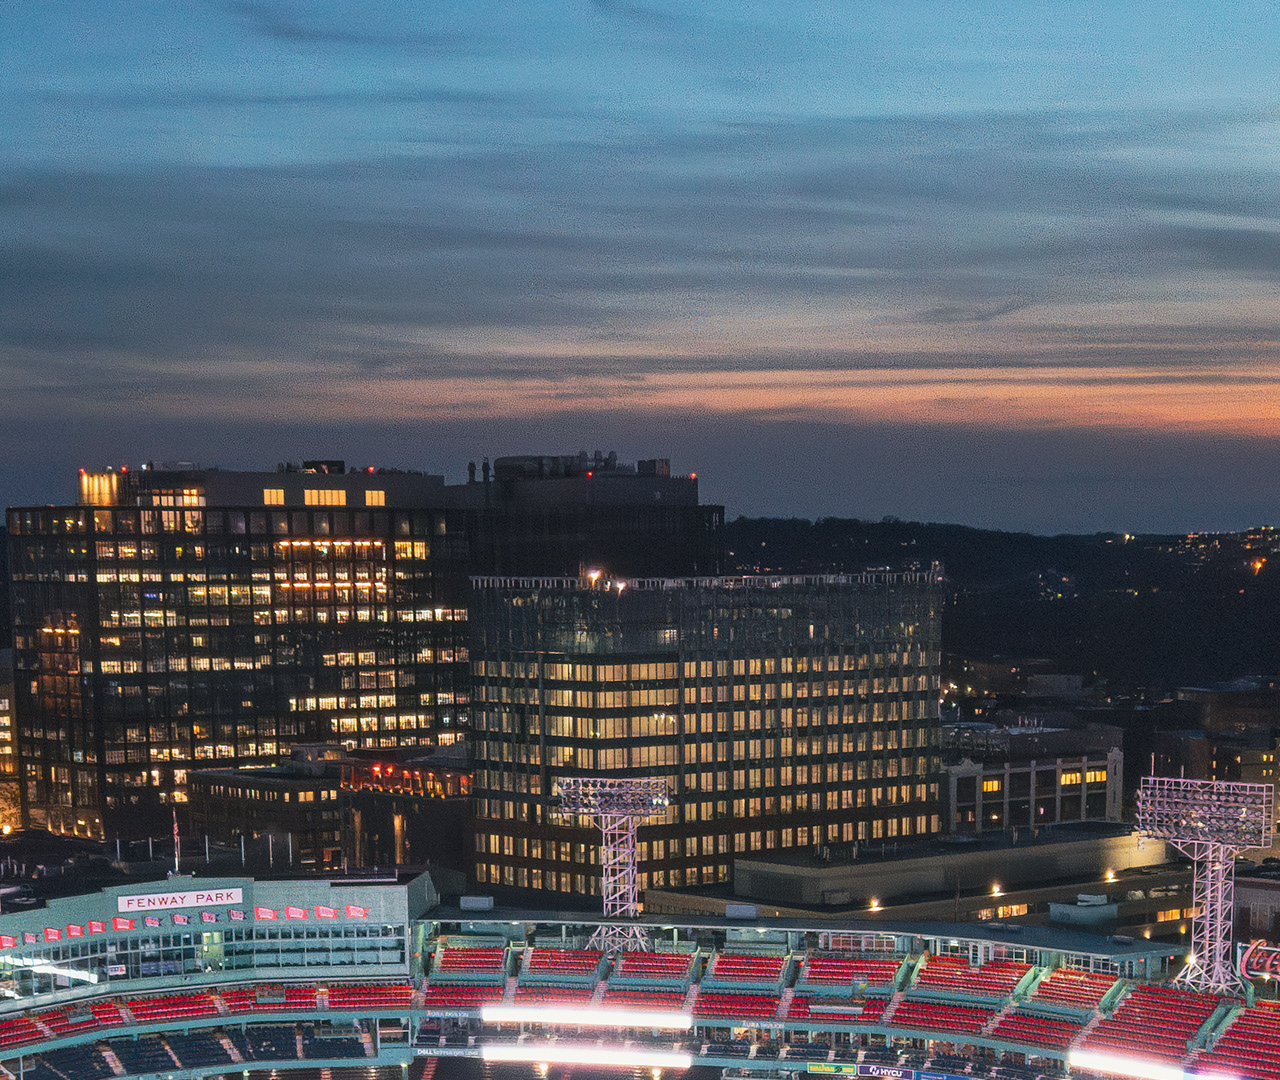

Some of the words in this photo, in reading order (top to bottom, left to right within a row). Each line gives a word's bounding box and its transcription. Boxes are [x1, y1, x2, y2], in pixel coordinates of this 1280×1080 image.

[127, 895, 187, 908] FENWAY
[196, 892, 234, 903] PARK
[880, 1067, 903, 1078] HYCU
